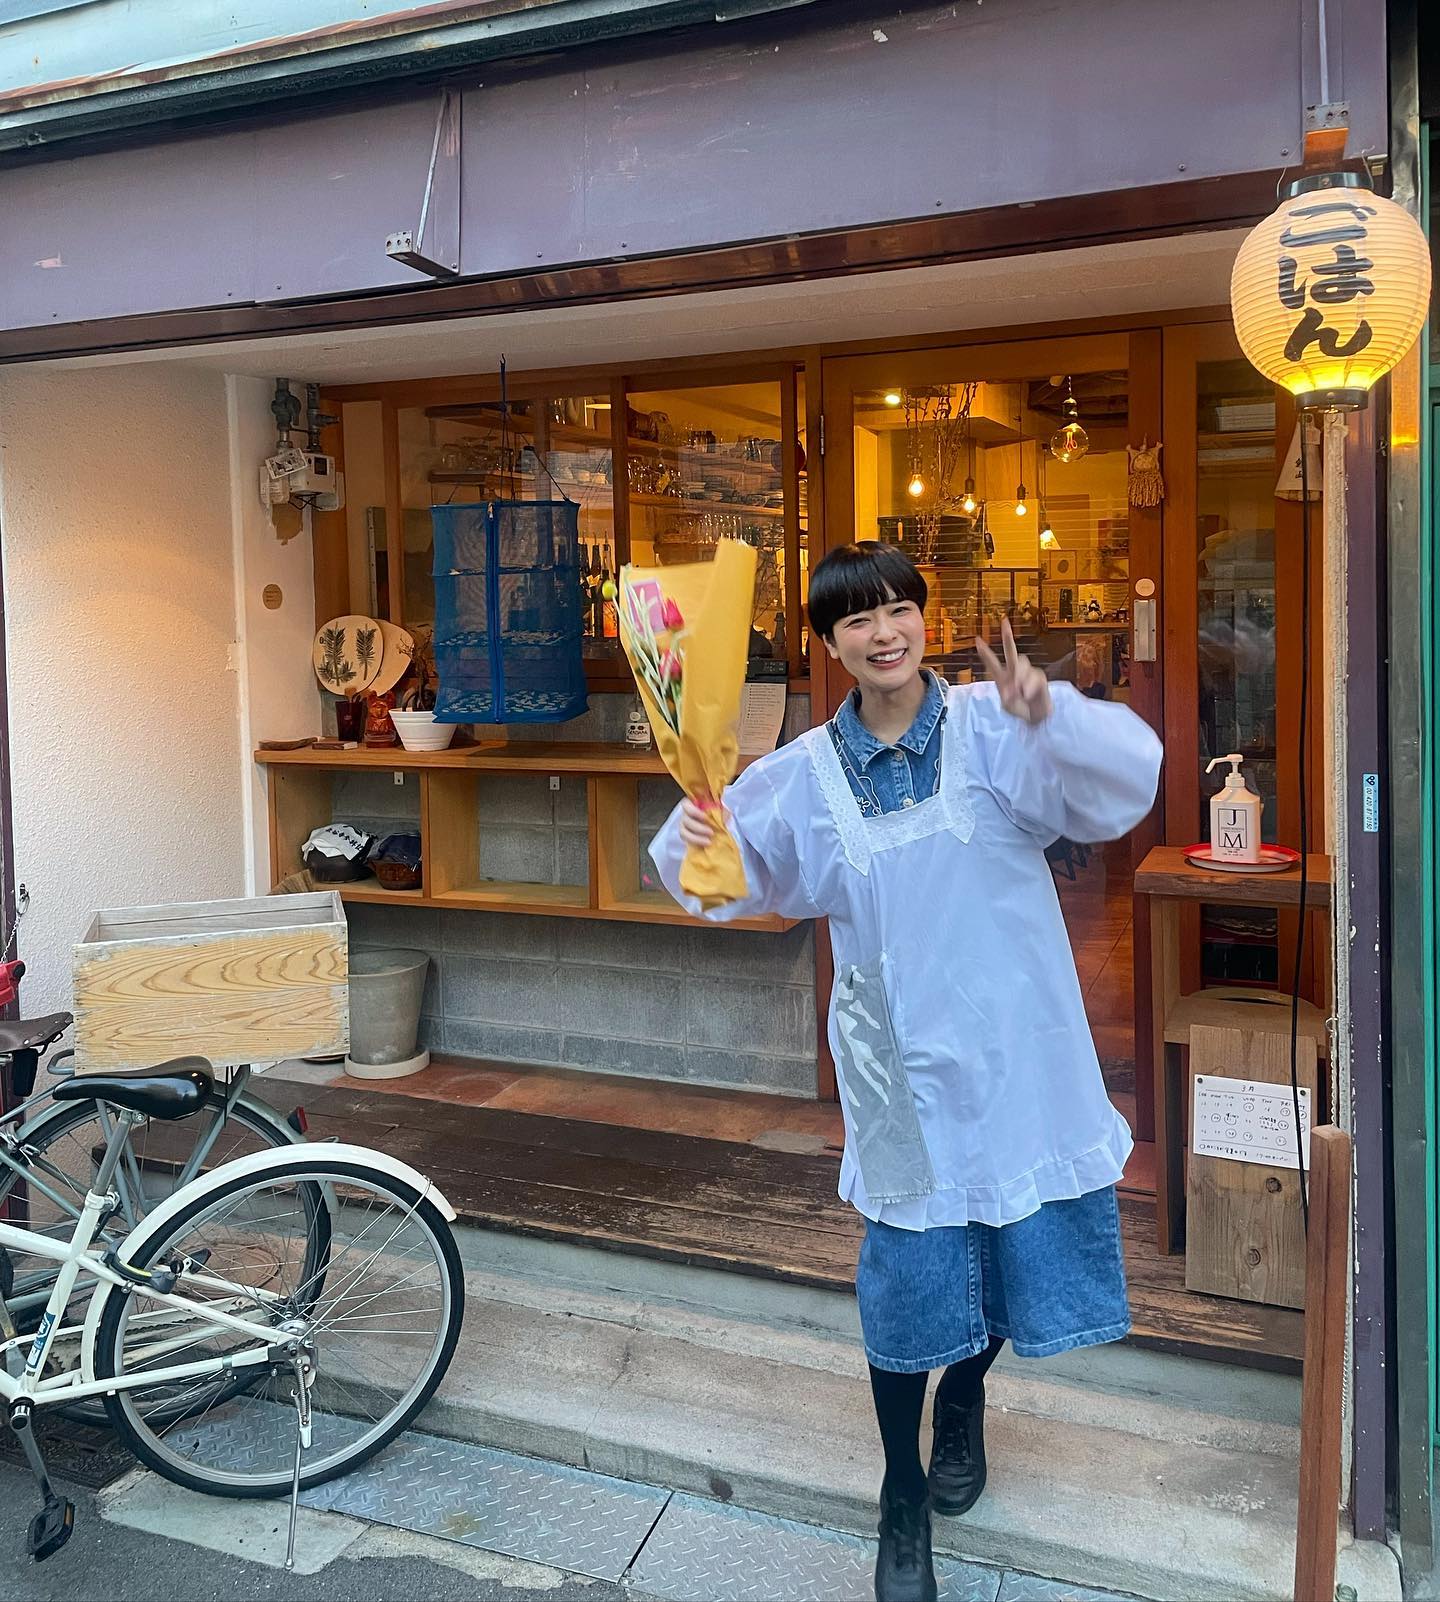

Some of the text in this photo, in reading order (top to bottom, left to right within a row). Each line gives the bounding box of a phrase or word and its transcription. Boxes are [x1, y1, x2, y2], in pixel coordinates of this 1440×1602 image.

[1277, 202, 1377, 362] ごはん
[1227, 809, 1237, 826] J
[1223, 832, 1243, 849] M
